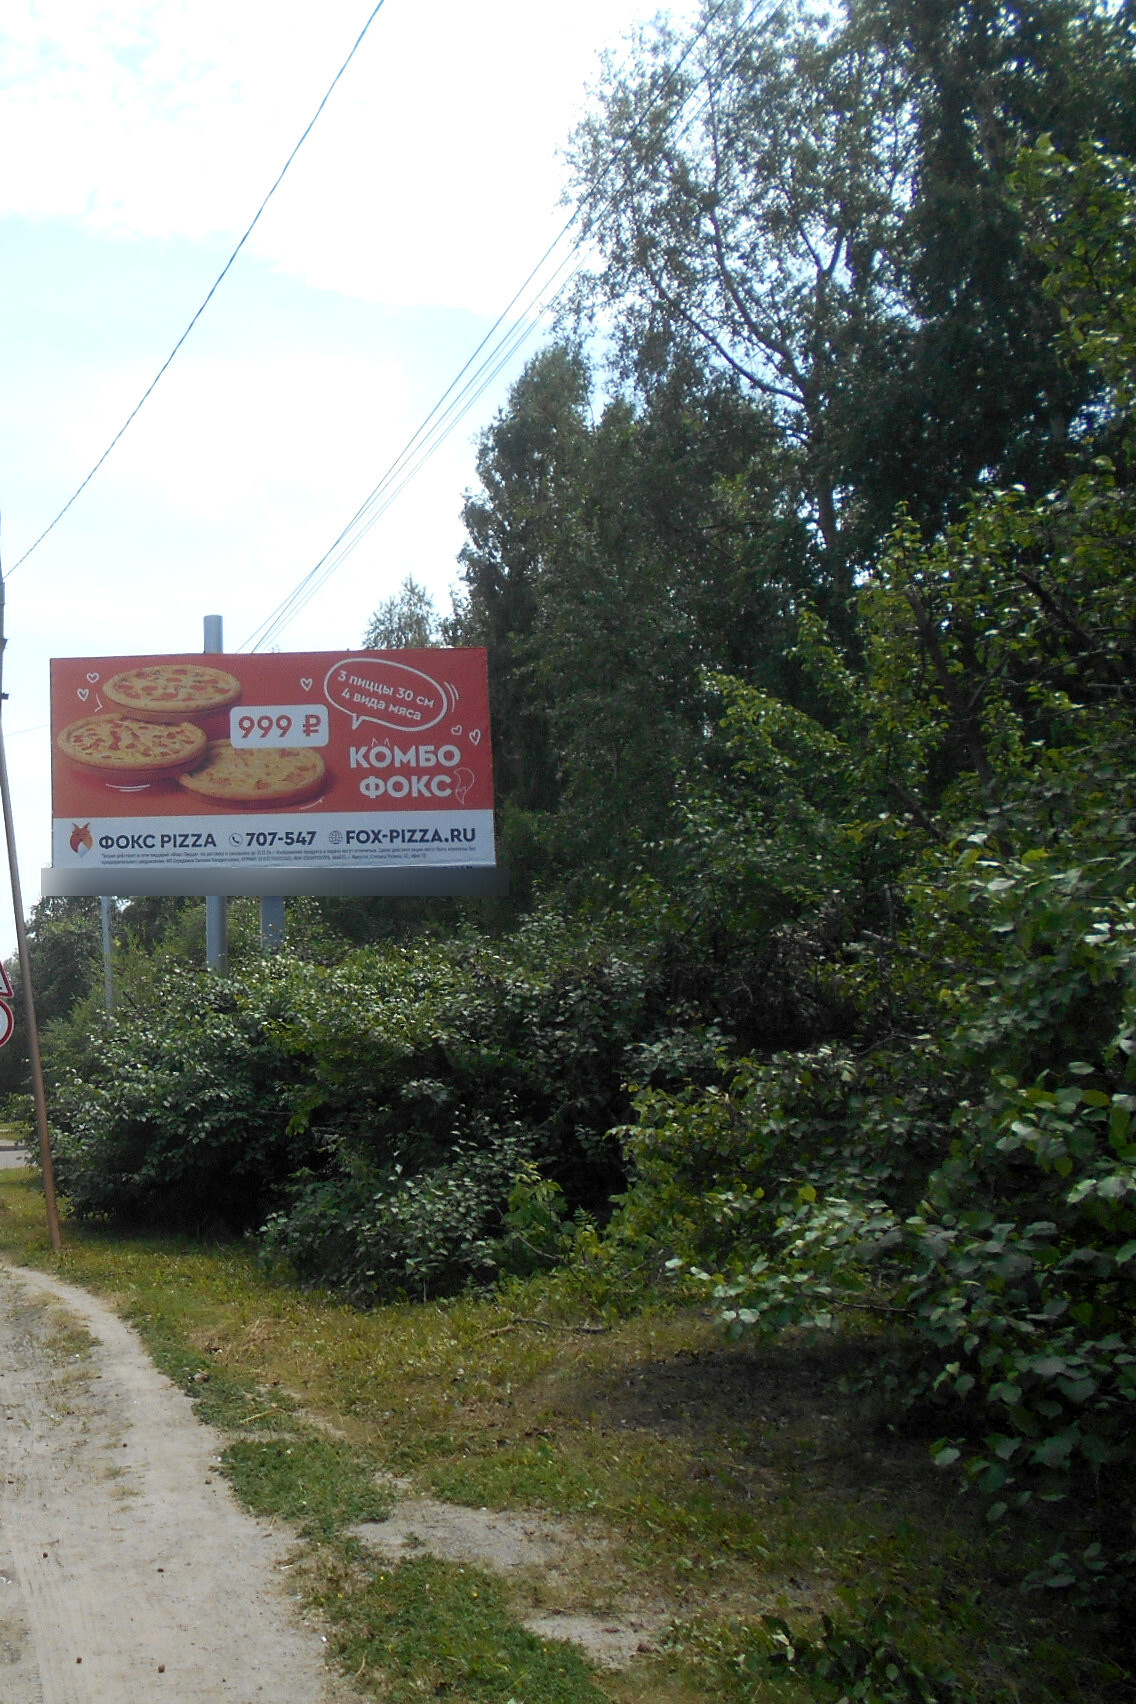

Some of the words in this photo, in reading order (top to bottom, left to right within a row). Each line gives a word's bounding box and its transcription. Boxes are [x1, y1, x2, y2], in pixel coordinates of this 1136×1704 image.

[338, 670, 348, 682] 3
[349, 675, 394, 696] пиццы
[396, 687, 414, 701] 30
[416, 696, 435, 708] см
[341, 688, 350, 699] 4
[353, 693, 386, 710] вида
[388, 703, 422, 721] мяса
[238, 714, 293, 739] 999
[349, 744, 461, 768] КОМБО
[359, 774, 453, 799] ФОКС
[98, 834, 156, 850] ФОКС
[160, 833, 217, 849] PIZZA
[245, 830, 317, 847] 707-547
[345, 827, 476, 845] FOX-PIZZA.RU
